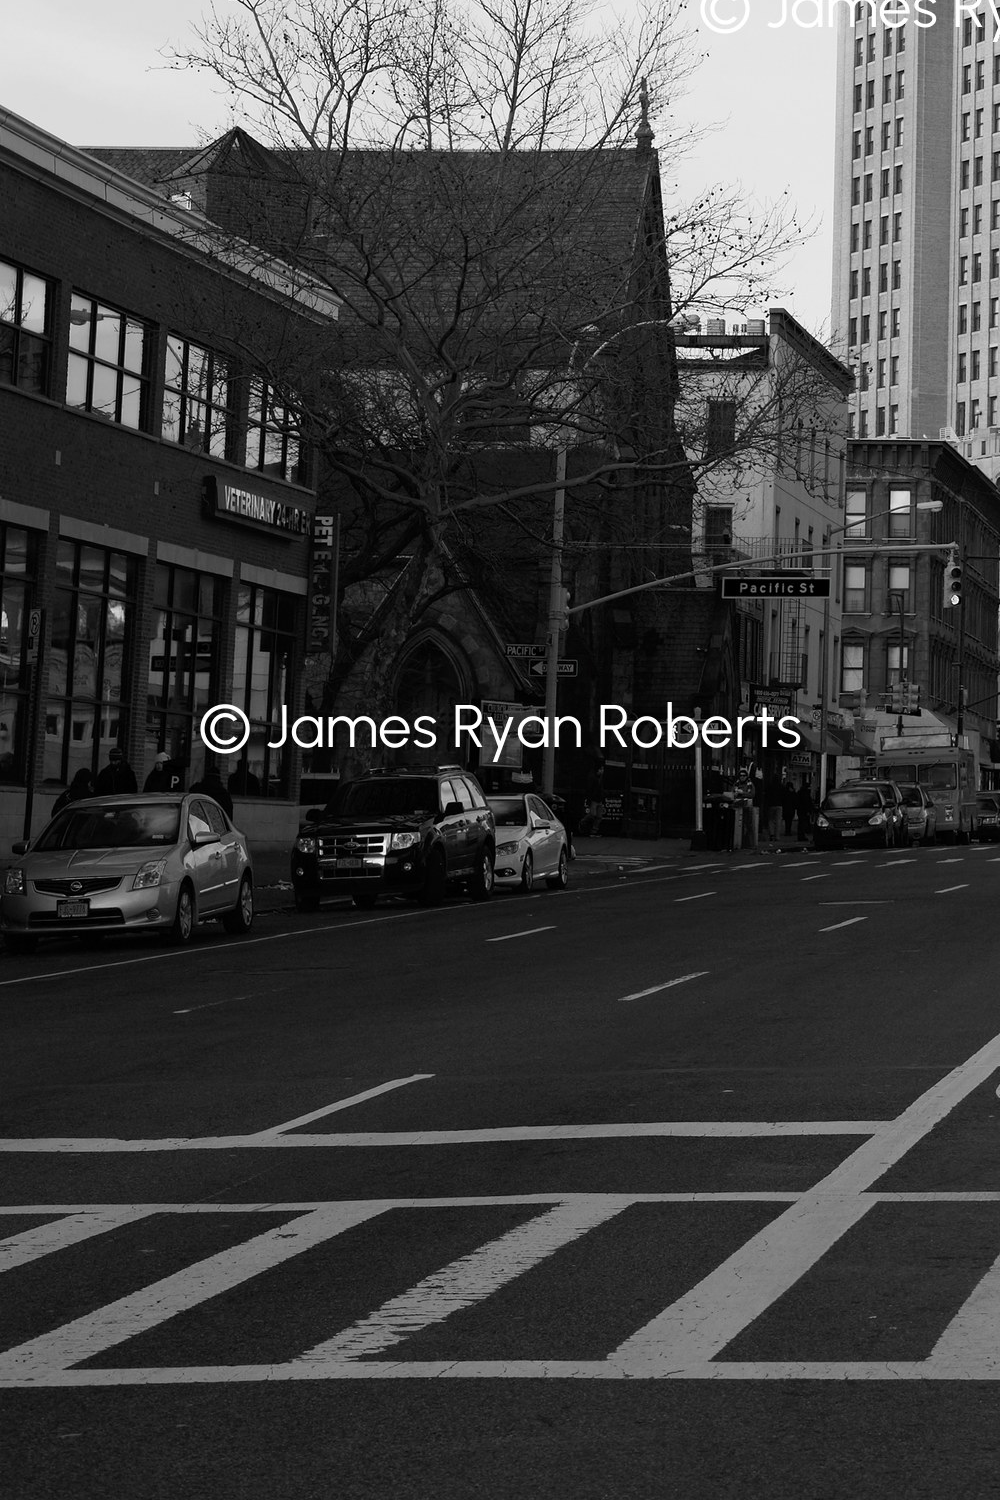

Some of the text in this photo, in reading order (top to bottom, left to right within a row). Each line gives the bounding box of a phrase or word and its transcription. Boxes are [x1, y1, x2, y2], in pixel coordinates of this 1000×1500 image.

[224, 485, 277, 525] VETERINARY
[314, 516, 334, 546] PET
[740, 583, 815, 593] Pacific St
[507, 647, 536, 656] PACIFIC
[768, 704, 790, 718] SERVICE
[792, 755, 810, 763] ATM
